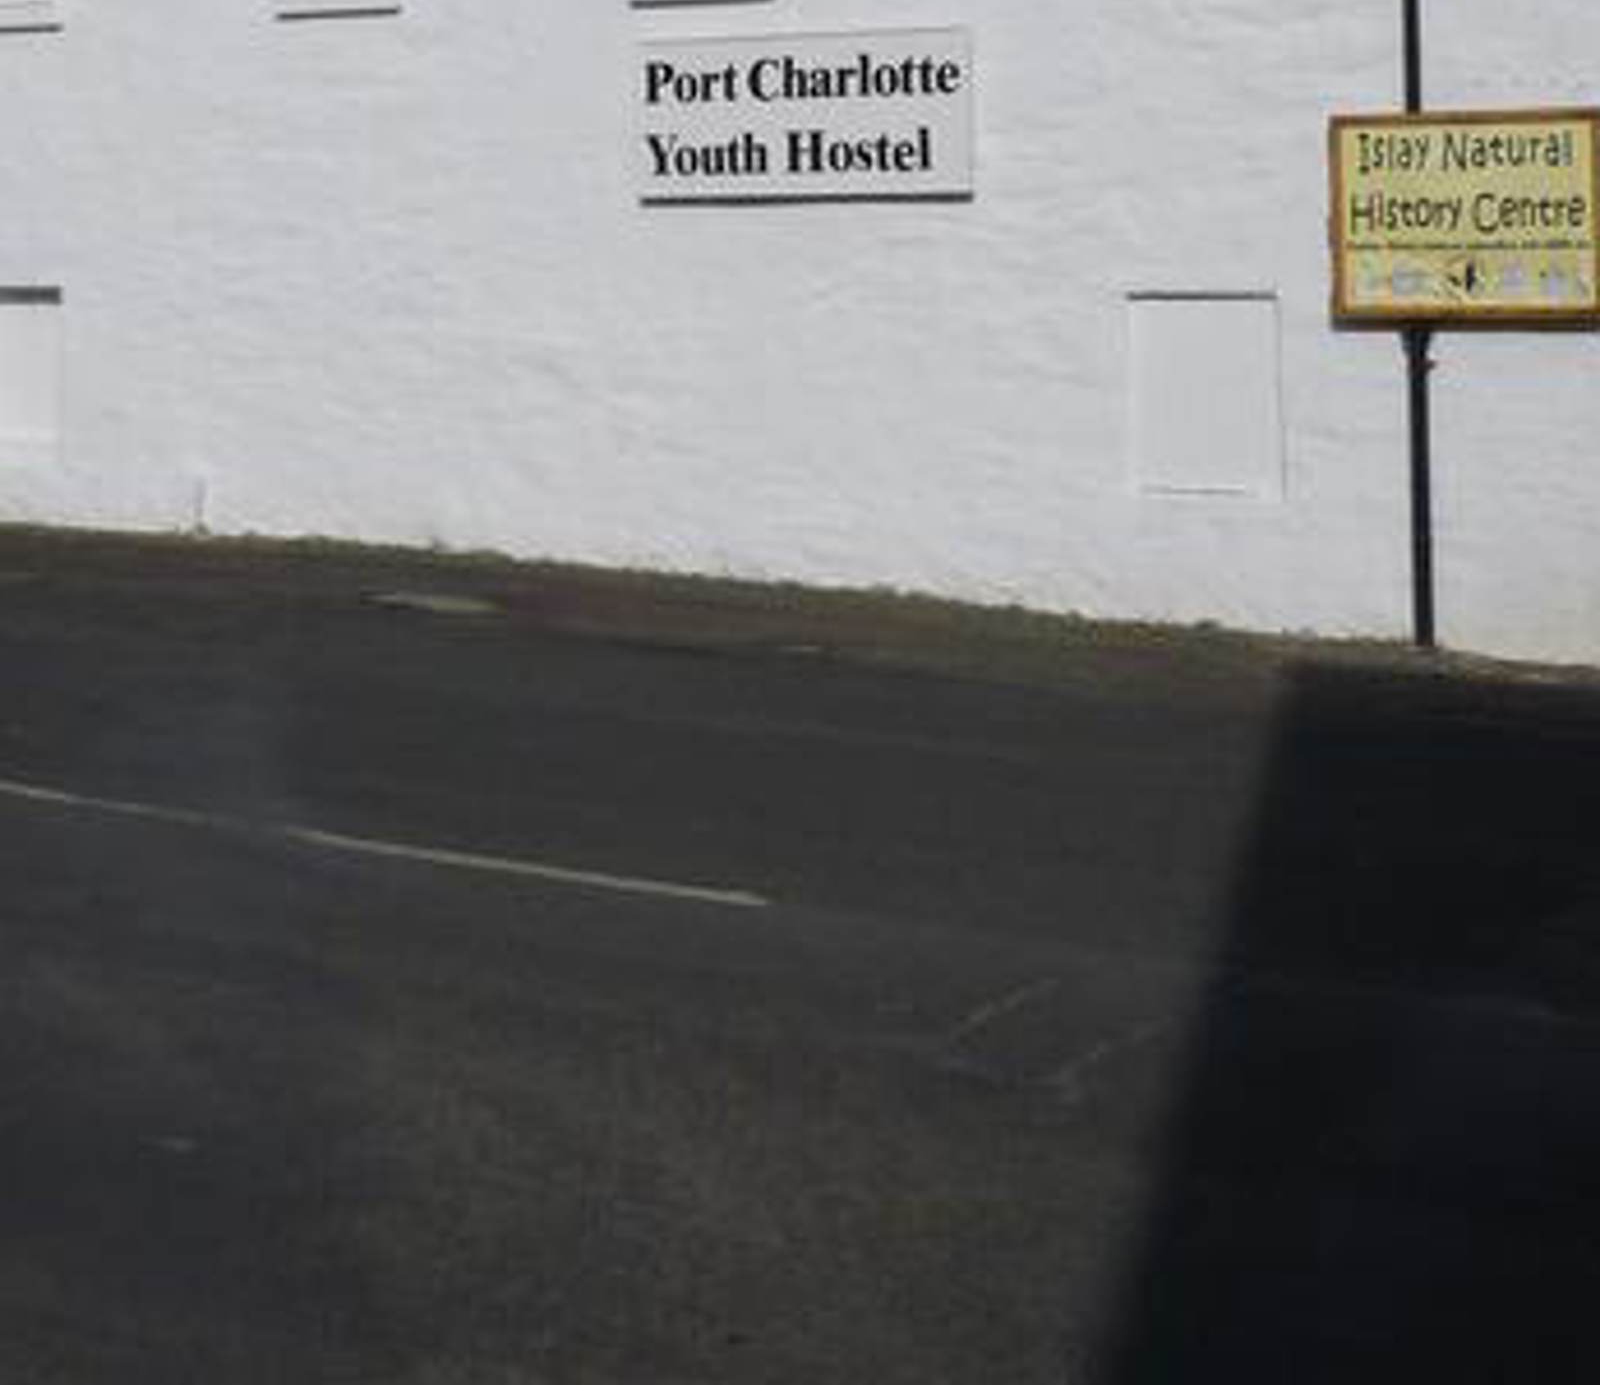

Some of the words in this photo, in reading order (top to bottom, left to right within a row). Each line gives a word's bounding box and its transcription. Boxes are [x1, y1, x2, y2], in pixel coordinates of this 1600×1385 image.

[646, 61, 738, 104] Port
[748, 54, 960, 102] Charlotte
[646, 132, 768, 176] Youth
[787, 126, 933, 173] Hostel
[1358, 132, 1430, 174] Islay
[1442, 130, 1573, 171] Natural
[1350, 192, 1463, 234] History
[1472, 193, 1586, 234] Centre
